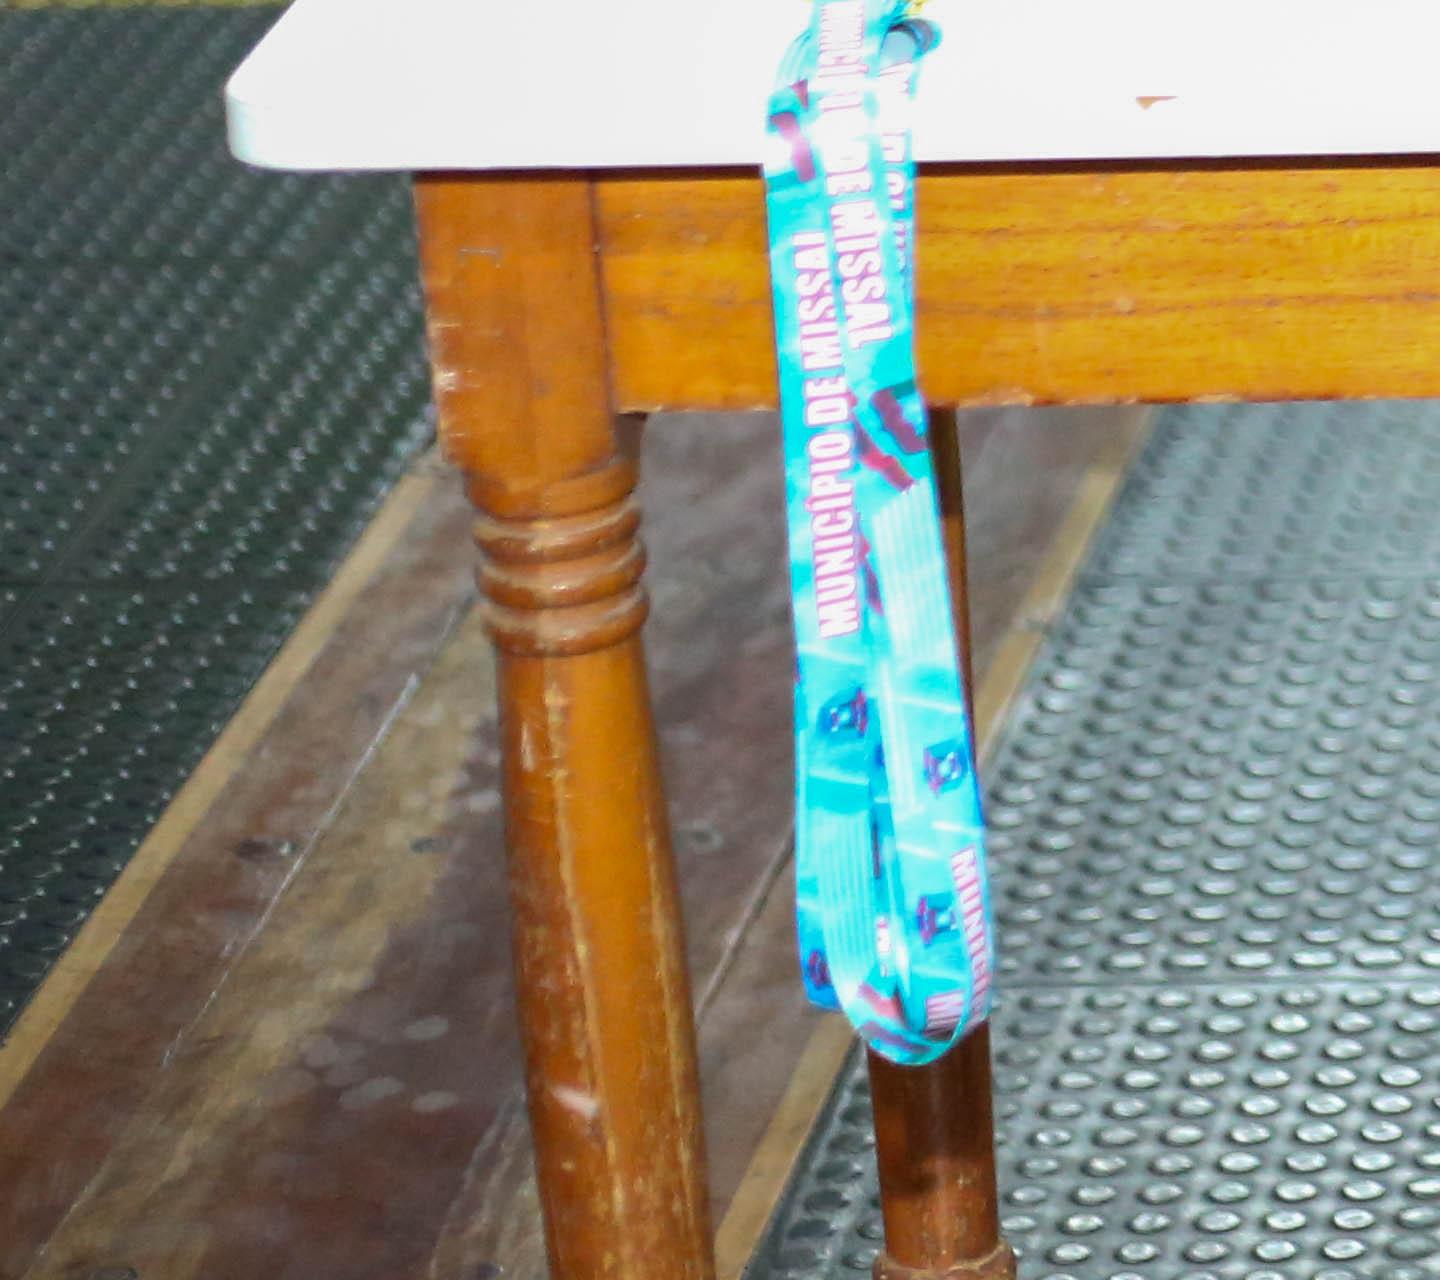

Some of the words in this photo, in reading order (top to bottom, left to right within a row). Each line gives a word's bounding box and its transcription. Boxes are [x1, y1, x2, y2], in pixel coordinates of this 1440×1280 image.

[830, 200, 894, 350] MISSAL
[803, 374, 847, 427] DE
[804, 430, 862, 639] MUNICÍPIO
